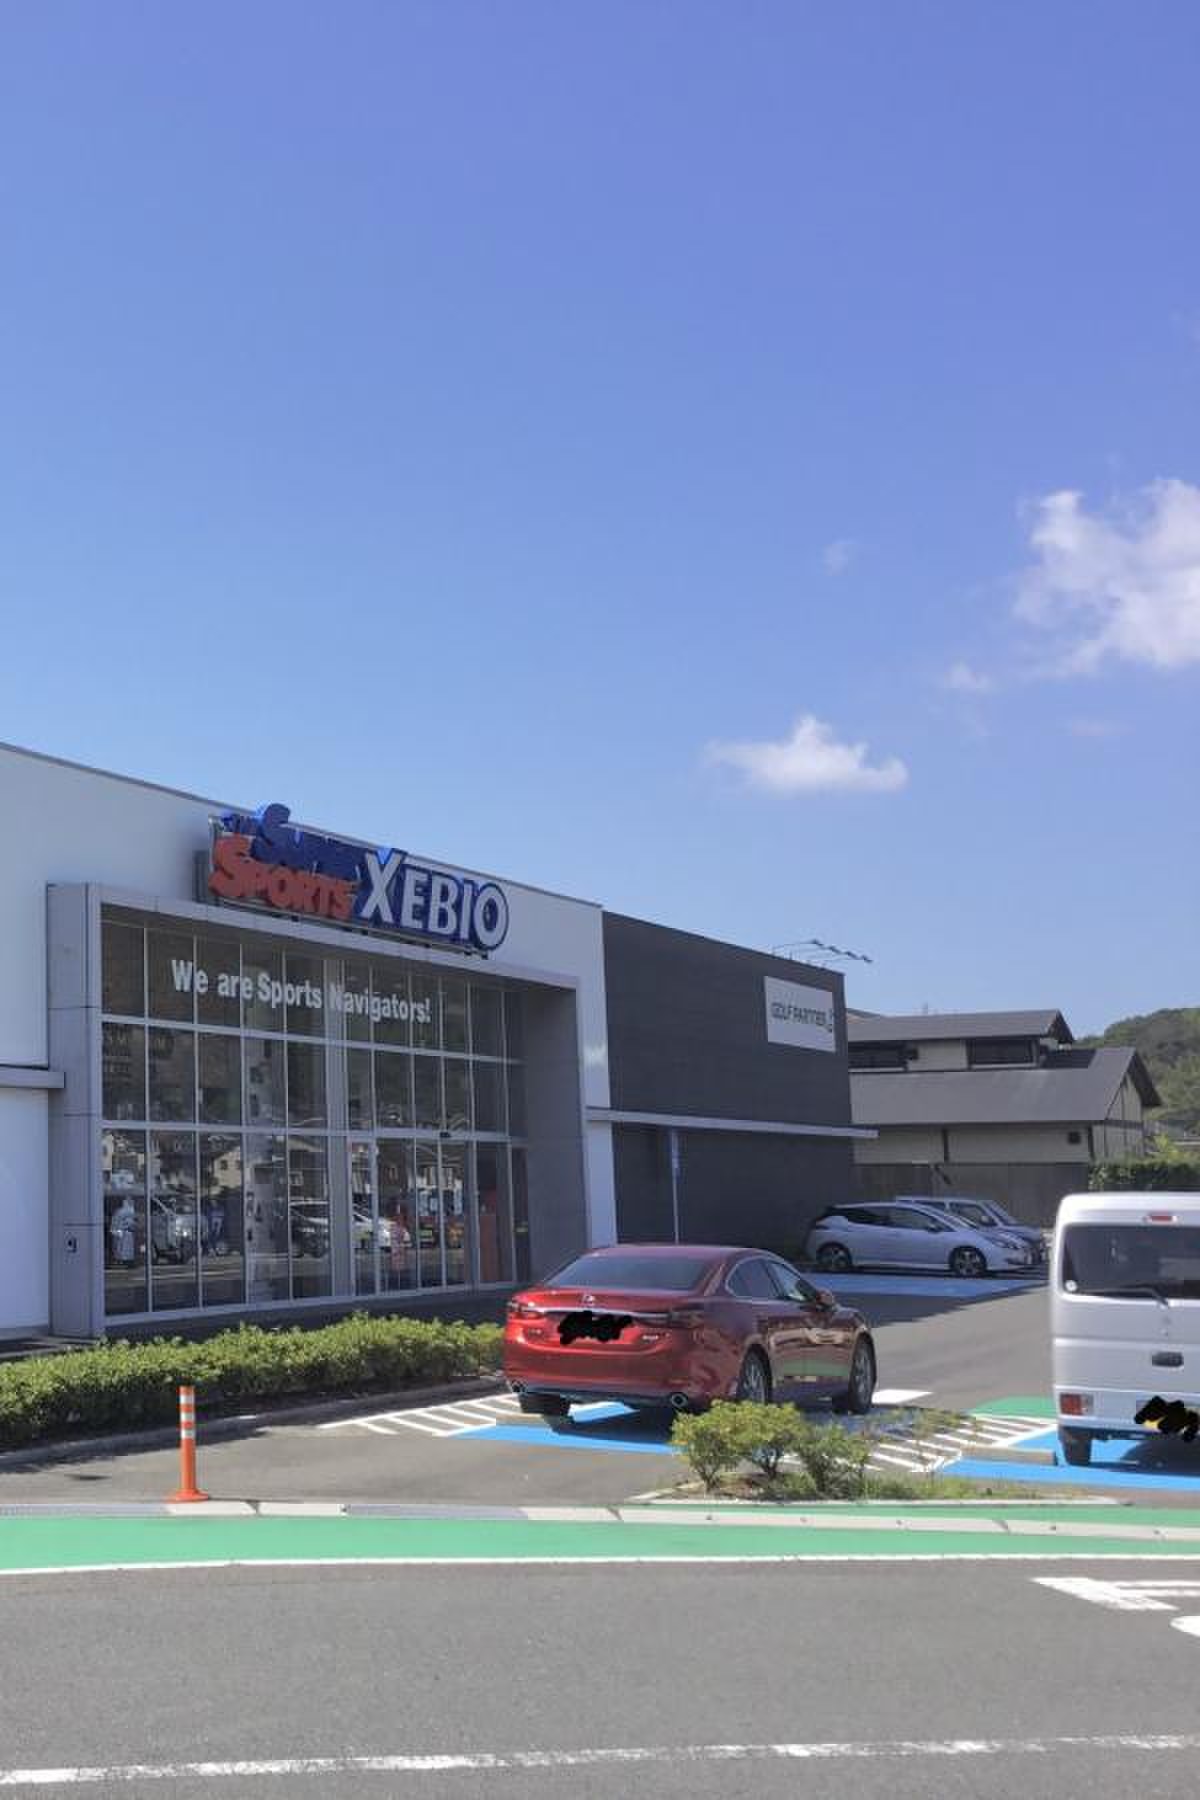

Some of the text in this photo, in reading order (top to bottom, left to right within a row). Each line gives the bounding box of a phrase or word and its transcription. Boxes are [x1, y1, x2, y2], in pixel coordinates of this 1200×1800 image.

[359, 848, 509, 951] XEBIO
[171, 959, 431, 1024] We are Sports Navigators!
